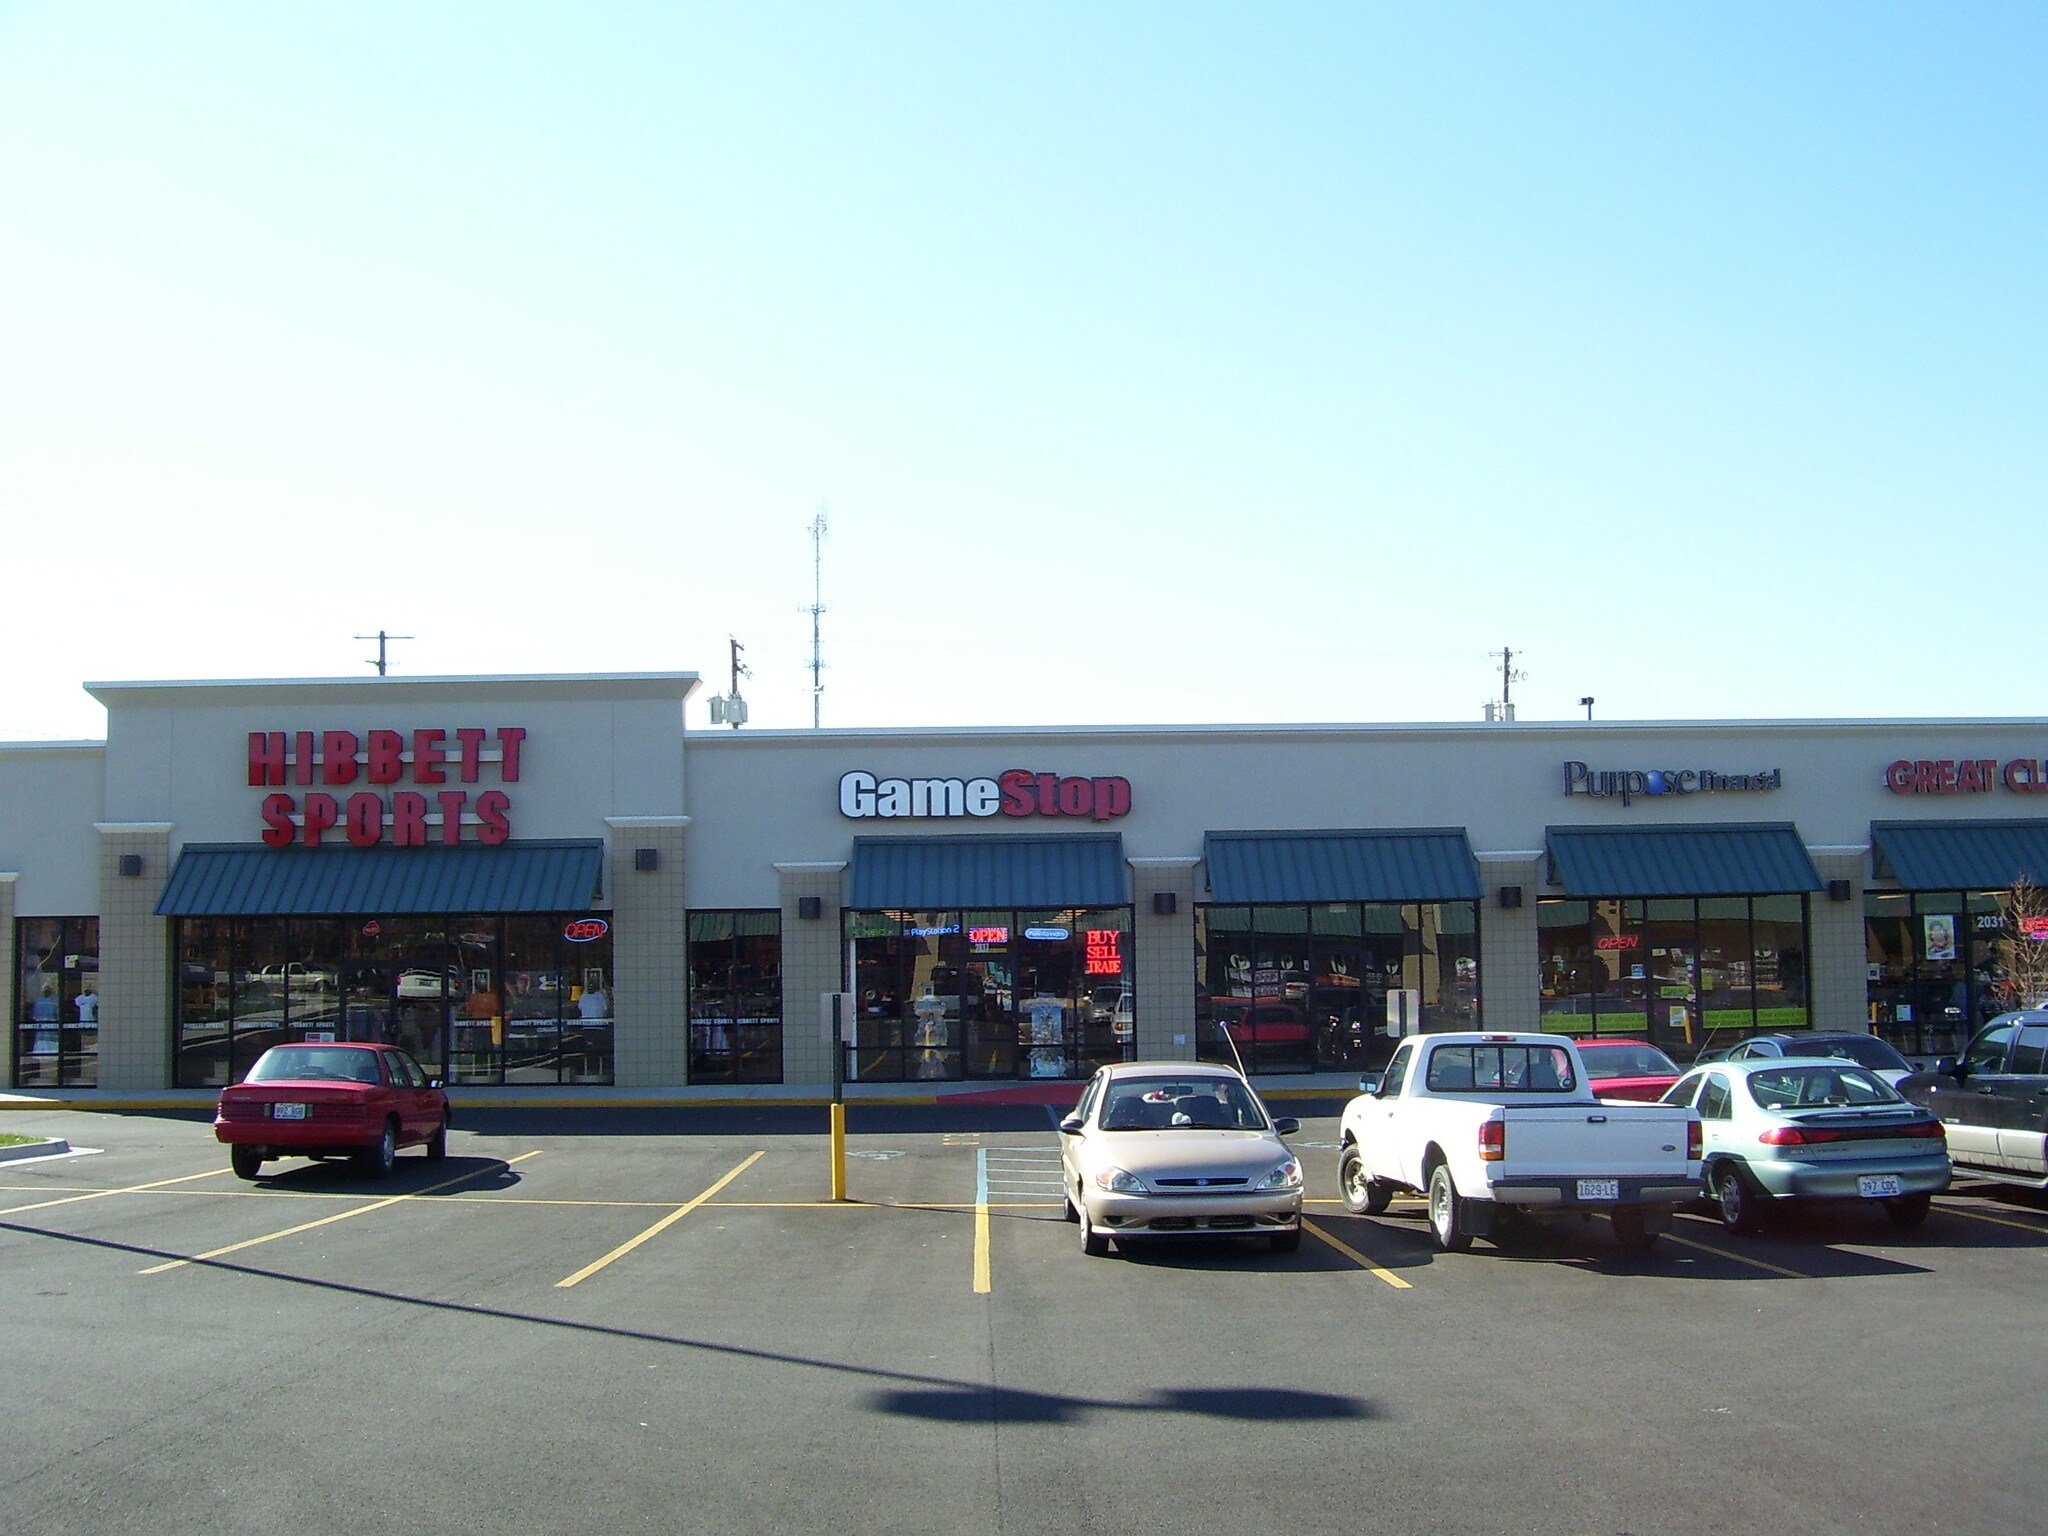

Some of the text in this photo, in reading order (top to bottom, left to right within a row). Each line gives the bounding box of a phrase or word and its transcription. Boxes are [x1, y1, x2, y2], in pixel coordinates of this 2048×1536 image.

[248, 728, 526, 786] HIBBETT
[1886, 758, 2048, 794] GREAT CL
[1563, 761, 1782, 807] Purpose Financial
[838, 769, 1132, 821] GameStop
[262, 791, 511, 848] SPORTS
[565, 921, 604, 938] OPEN
[953, 925, 960, 933] 2
[1977, 916, 2003, 928] 2031
[972, 929, 1006, 941] OPEN
[1087, 930, 1120, 945] BUY
[1598, 936, 1639, 949] OPEN
[1087, 946, 1121, 959] SELL
[1087, 960, 1121, 974] TRADE
